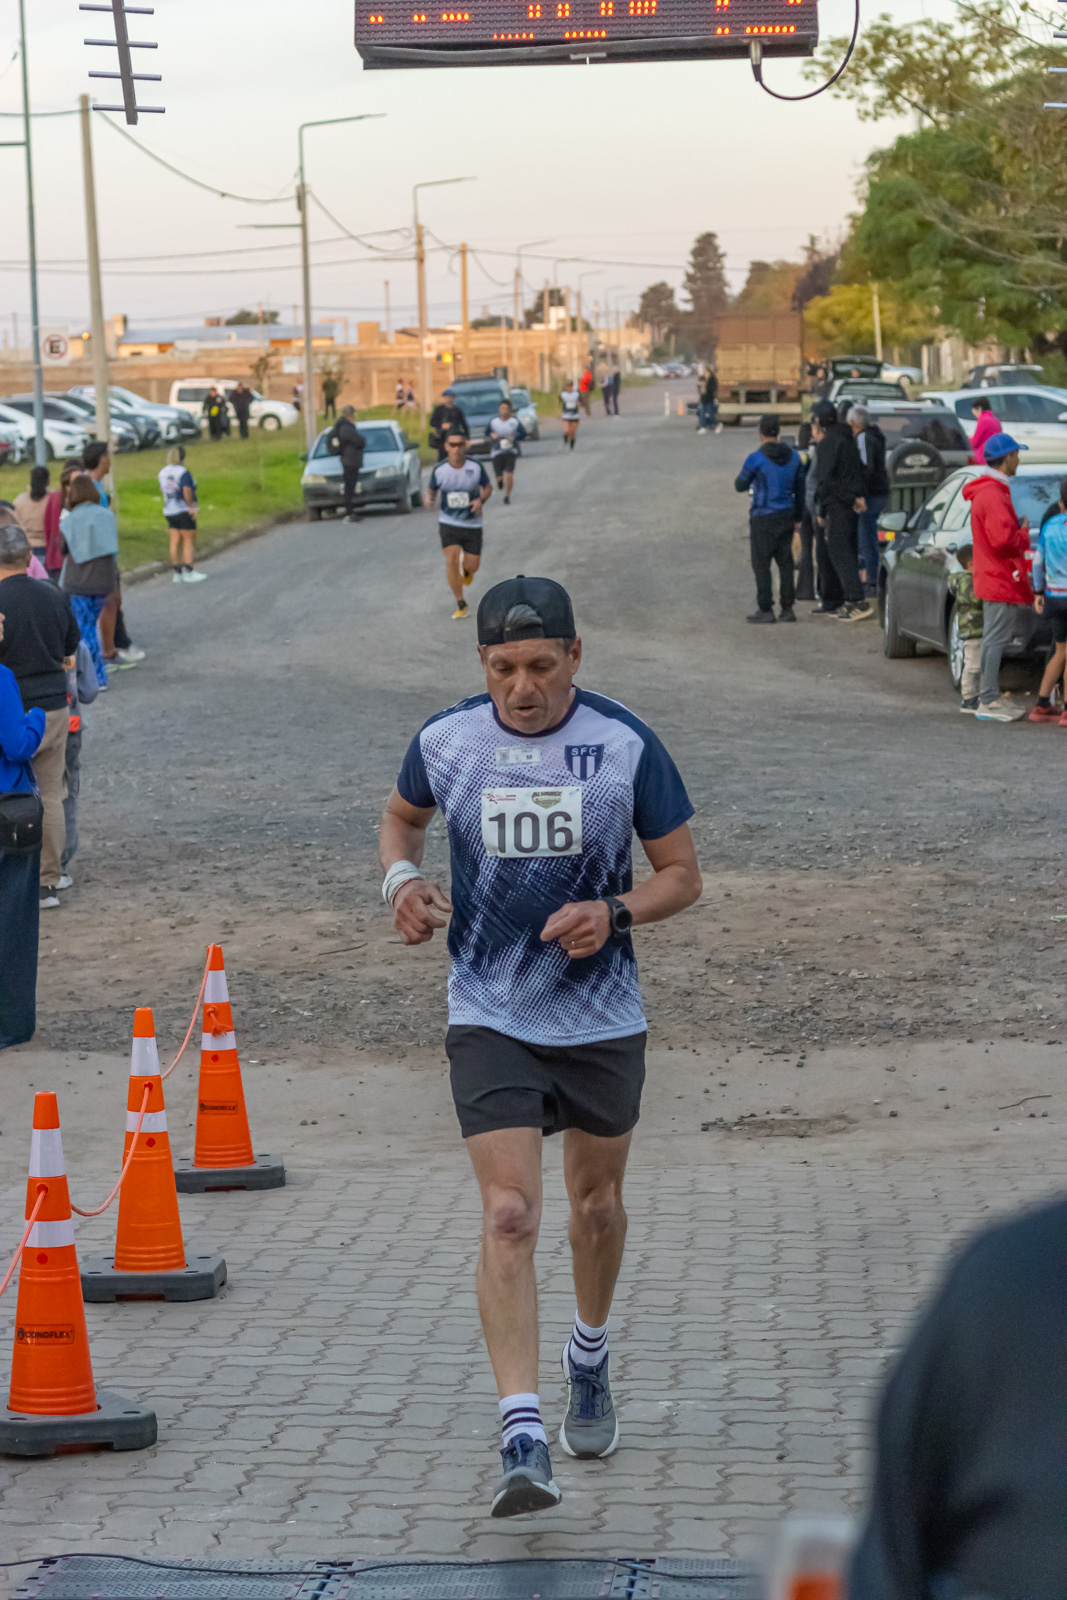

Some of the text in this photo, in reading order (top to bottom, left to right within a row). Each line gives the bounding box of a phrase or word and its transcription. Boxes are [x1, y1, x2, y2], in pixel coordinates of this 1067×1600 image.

[571, 746, 597, 756] SFC
[488, 811, 573, 854] 106
[25, 1331, 71, 1339] CONOFLEX
